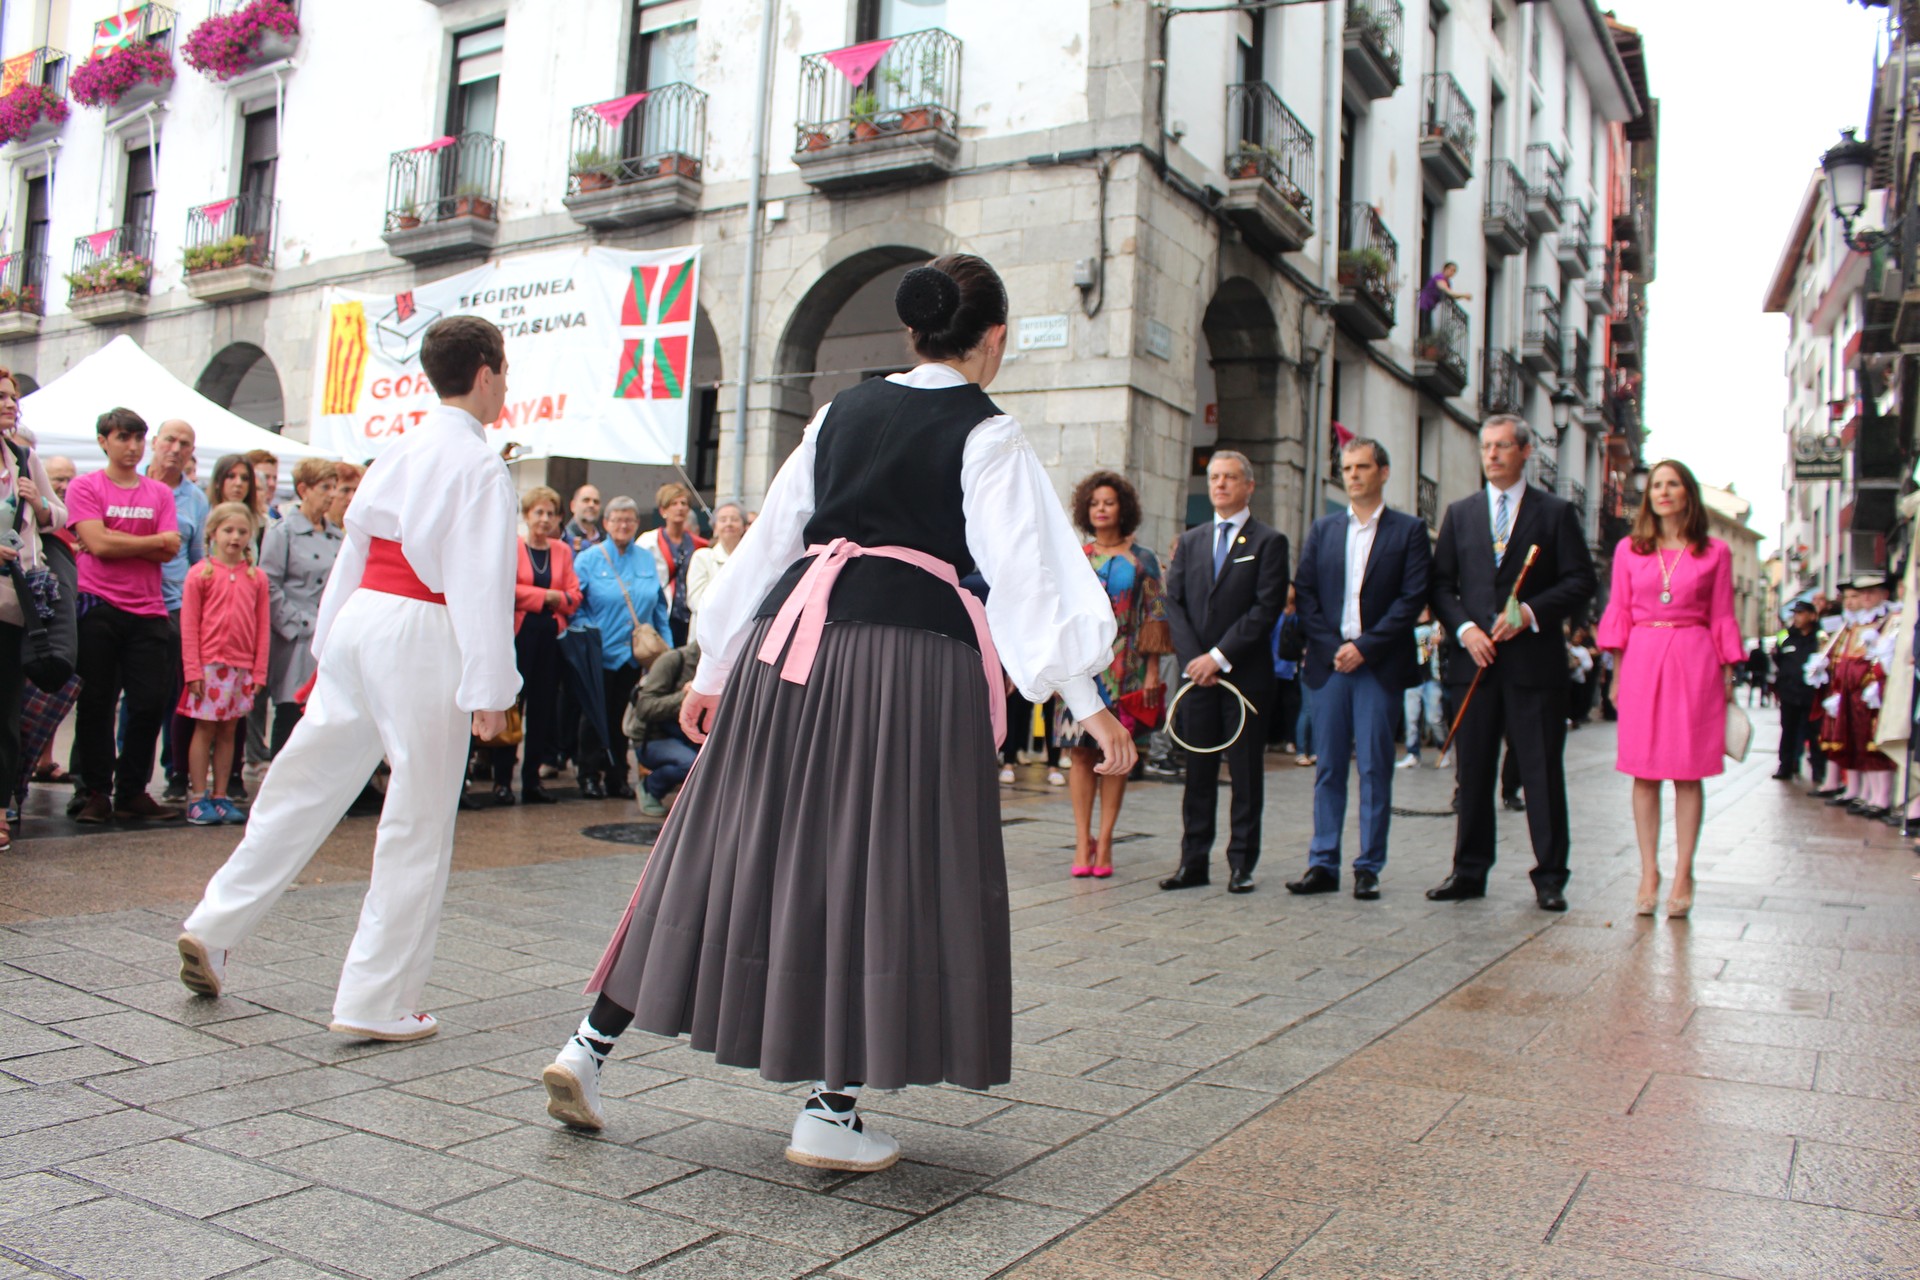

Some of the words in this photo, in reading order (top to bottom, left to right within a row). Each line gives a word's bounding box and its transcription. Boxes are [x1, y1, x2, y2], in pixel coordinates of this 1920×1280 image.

[500, 305, 526, 319] ETA
[371, 372, 436, 399] GOR
[364, 394, 567, 438] CATNYA!
[106, 505, 154, 519] ENDLESS
